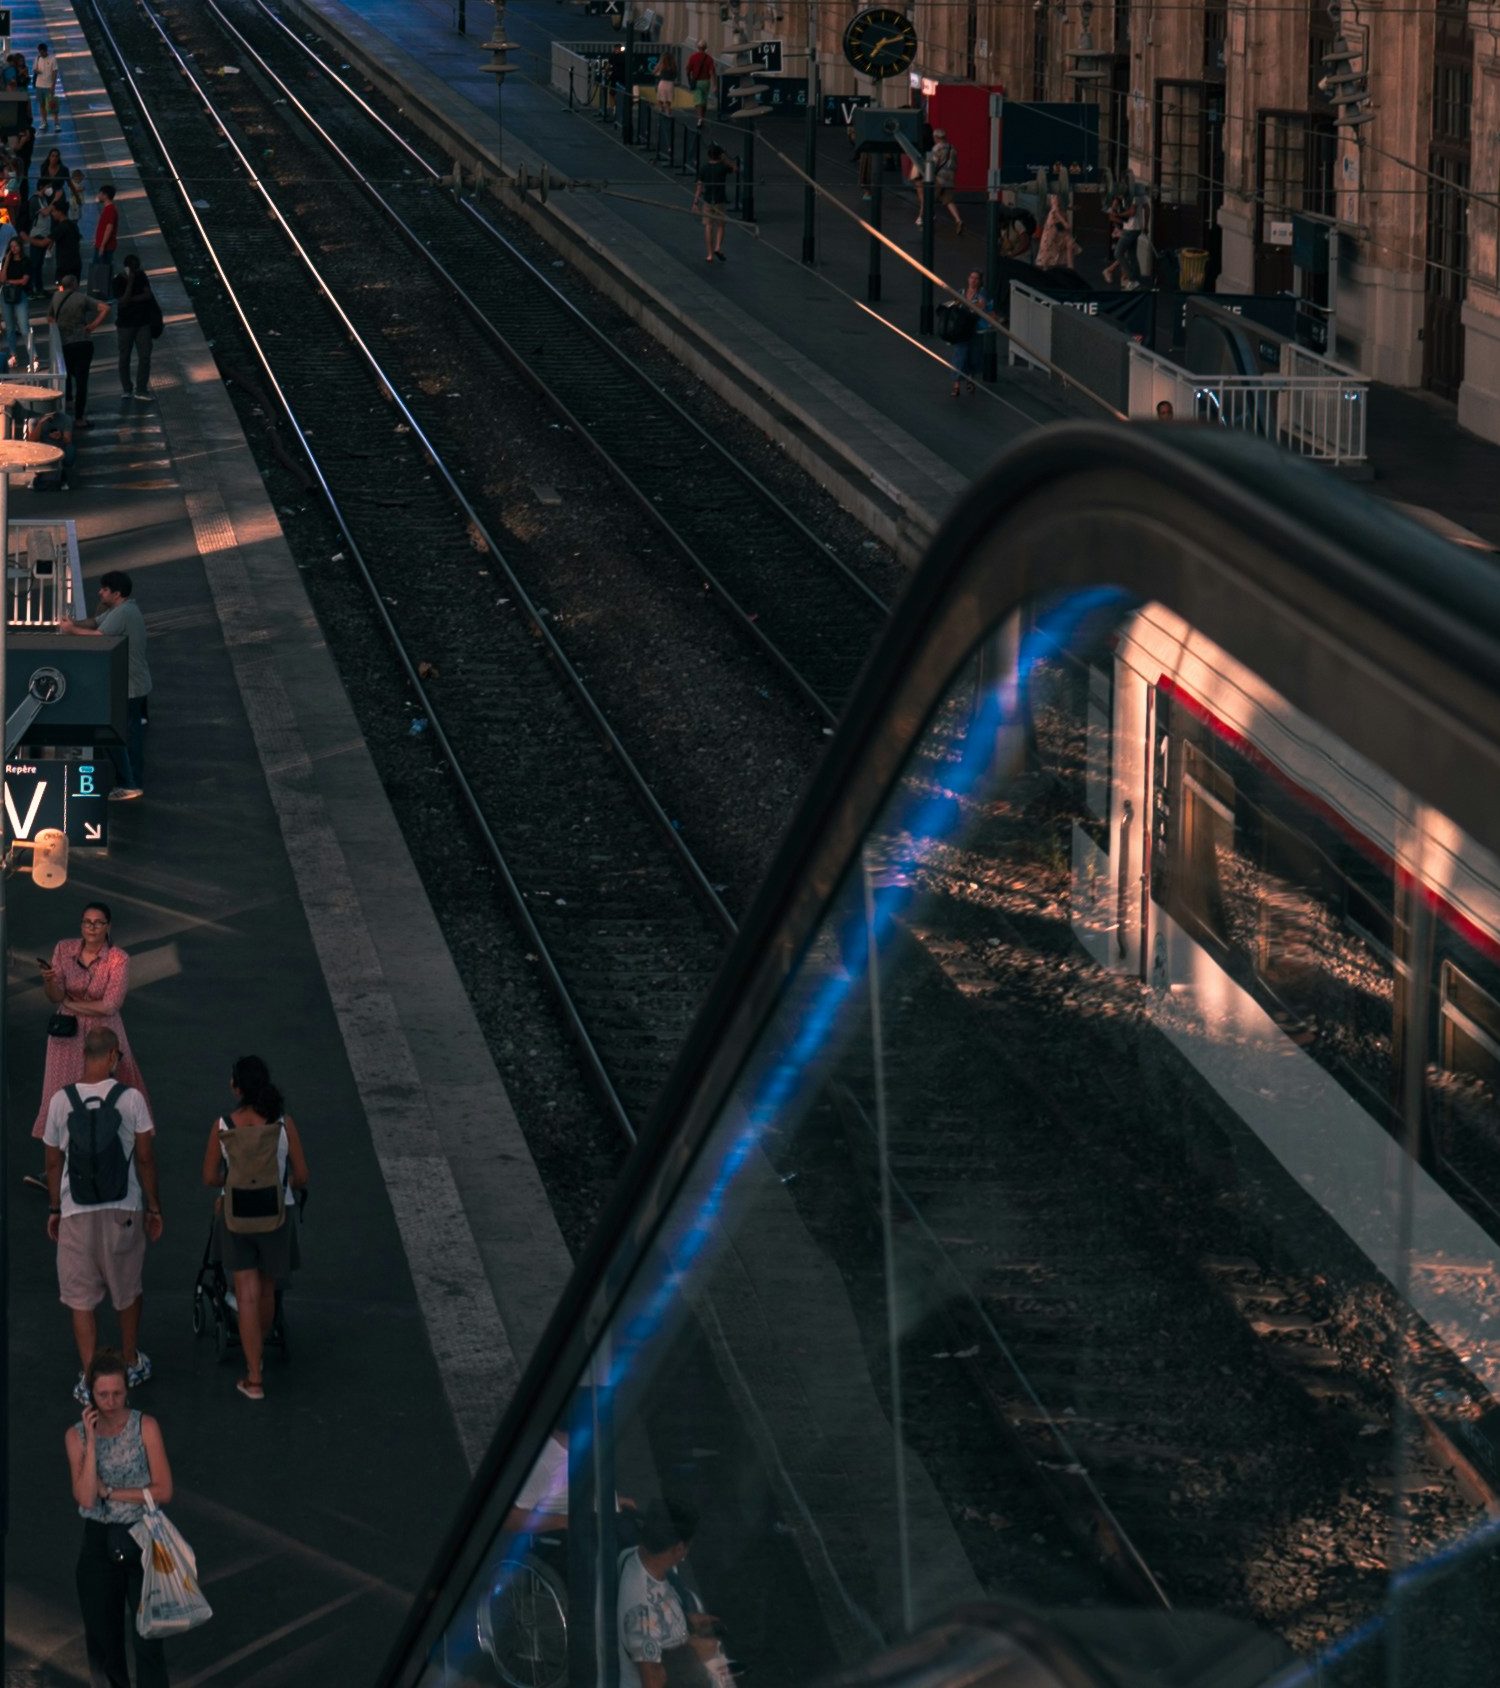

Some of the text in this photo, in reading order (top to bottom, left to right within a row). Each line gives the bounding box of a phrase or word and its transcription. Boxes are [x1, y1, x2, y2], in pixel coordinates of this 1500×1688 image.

[762, 55, 769, 70] 1
[5, 764, 37, 775] Repère
[80, 775, 94, 793] B
[4, 781, 48, 839] V
